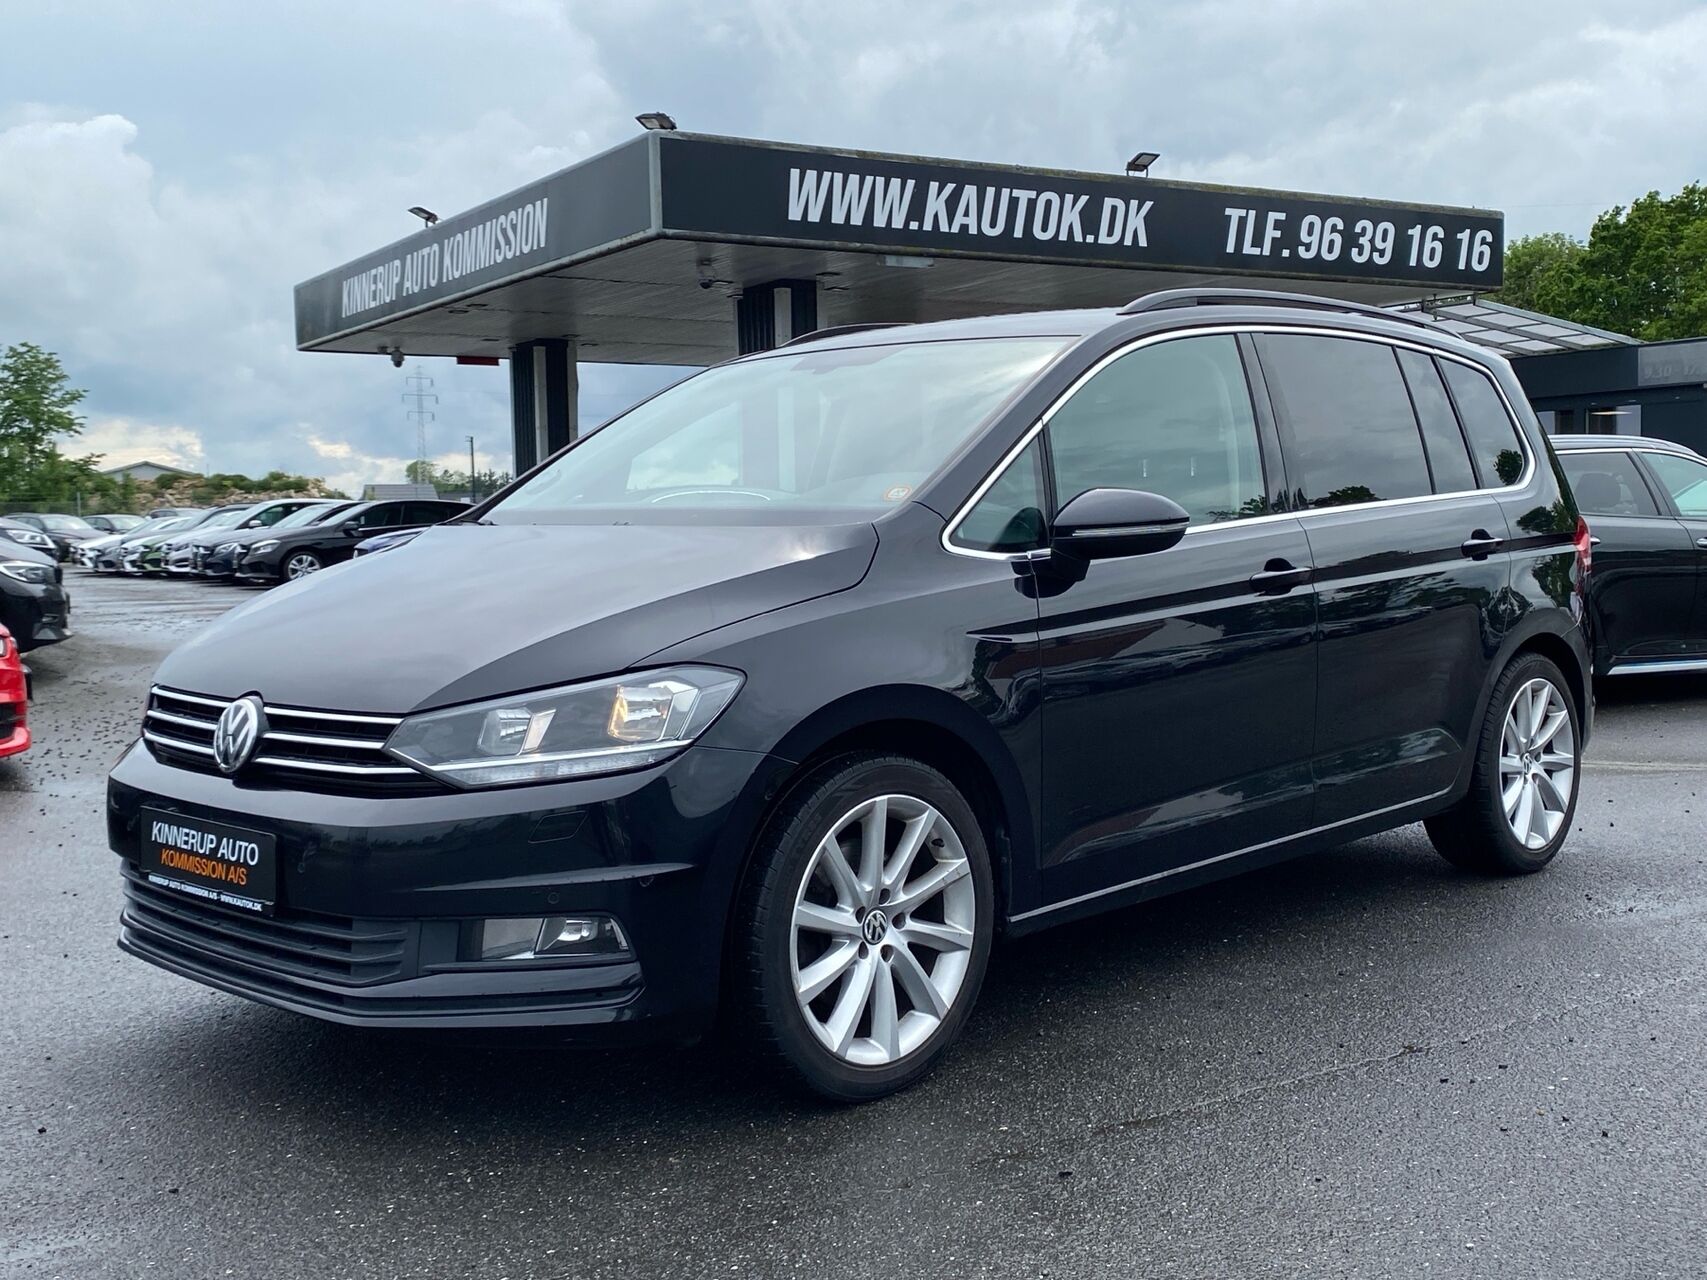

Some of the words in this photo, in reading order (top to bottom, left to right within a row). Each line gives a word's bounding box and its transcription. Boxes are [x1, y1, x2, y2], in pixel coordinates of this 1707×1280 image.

[788, 168, 1154, 247] WWW.KAUTOK.DK
[1224, 207, 1290, 258] TLF.
[1298, 214, 1344, 261] 96
[1351, 219, 1395, 265] 39
[1407, 224, 1445, 269] 16
[1457, 229, 1493, 272] 16
[341, 259, 401, 318] KINNERUP
[403, 243, 440, 296] AUTO
[442, 198, 548, 283] KOMMISSION
[152, 821, 216, 855] KINNERUP
[217, 837, 259, 866] AUTO
[160, 848, 226, 880] KOMMISSION
[227, 866, 247, 885] A/S
